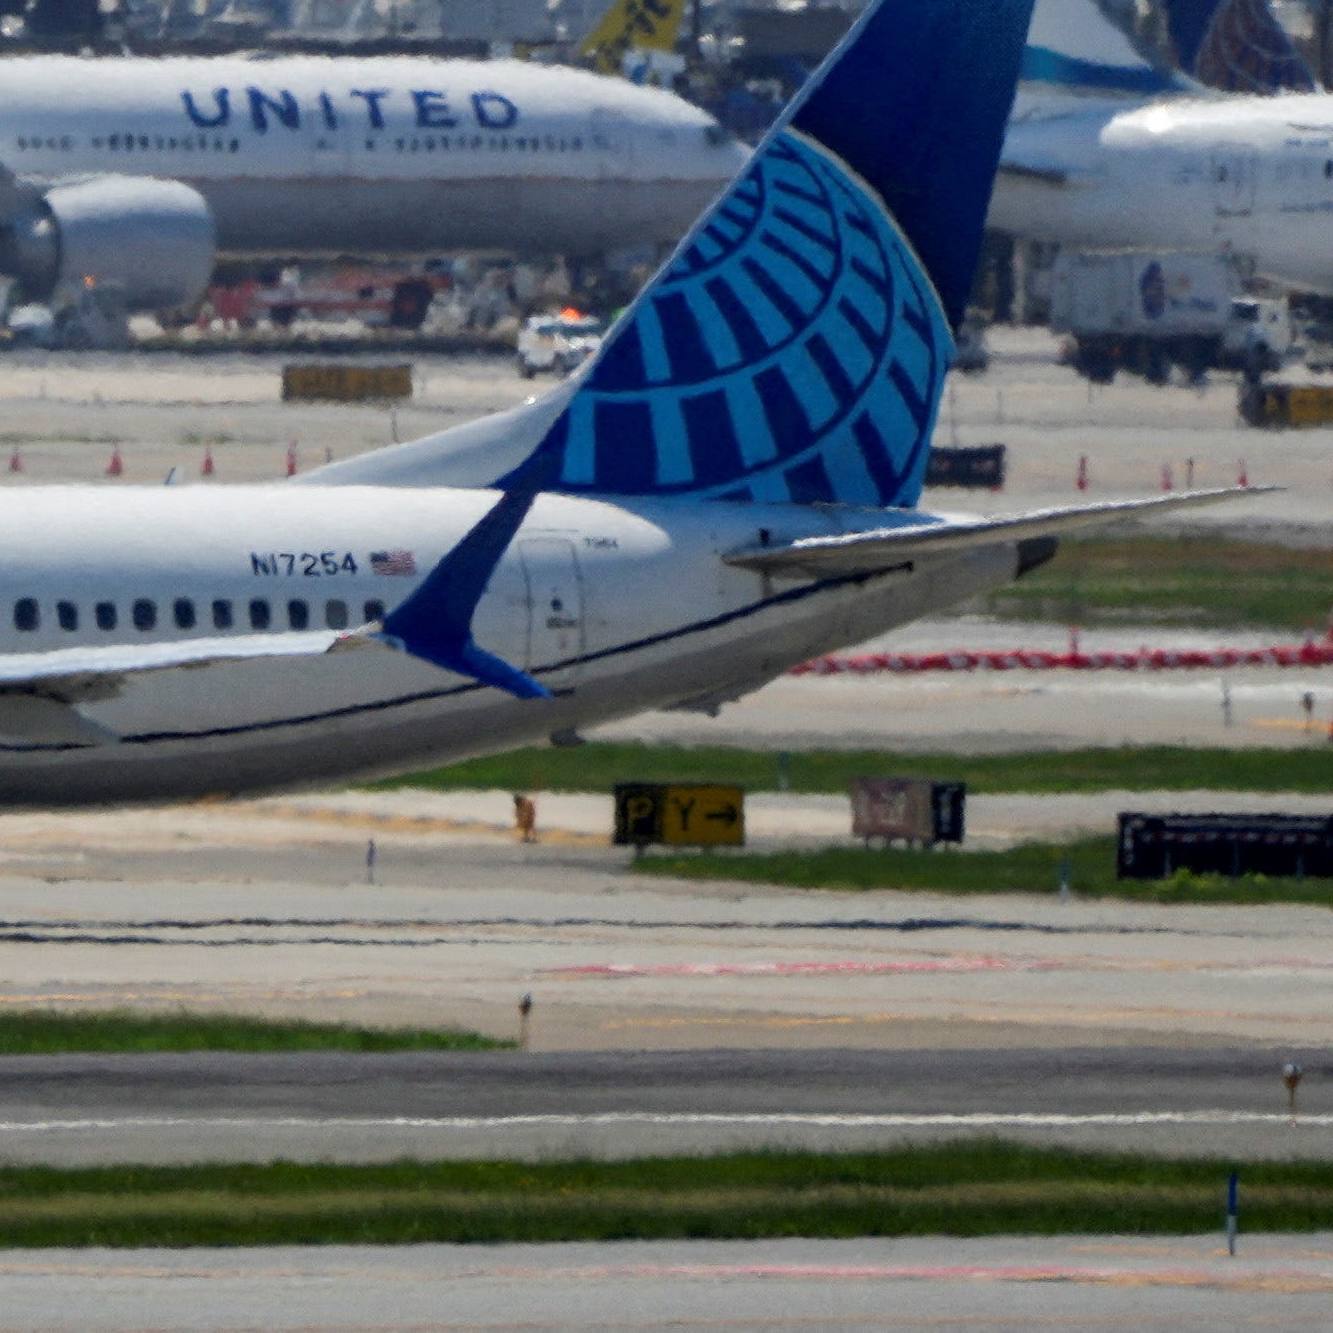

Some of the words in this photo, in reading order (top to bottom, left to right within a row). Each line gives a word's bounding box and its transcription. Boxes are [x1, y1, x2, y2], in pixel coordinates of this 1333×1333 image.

[181, 87, 518, 134] UNITED
[250, 552, 358, 577] N17254
[674, 796, 695, 832] Y
